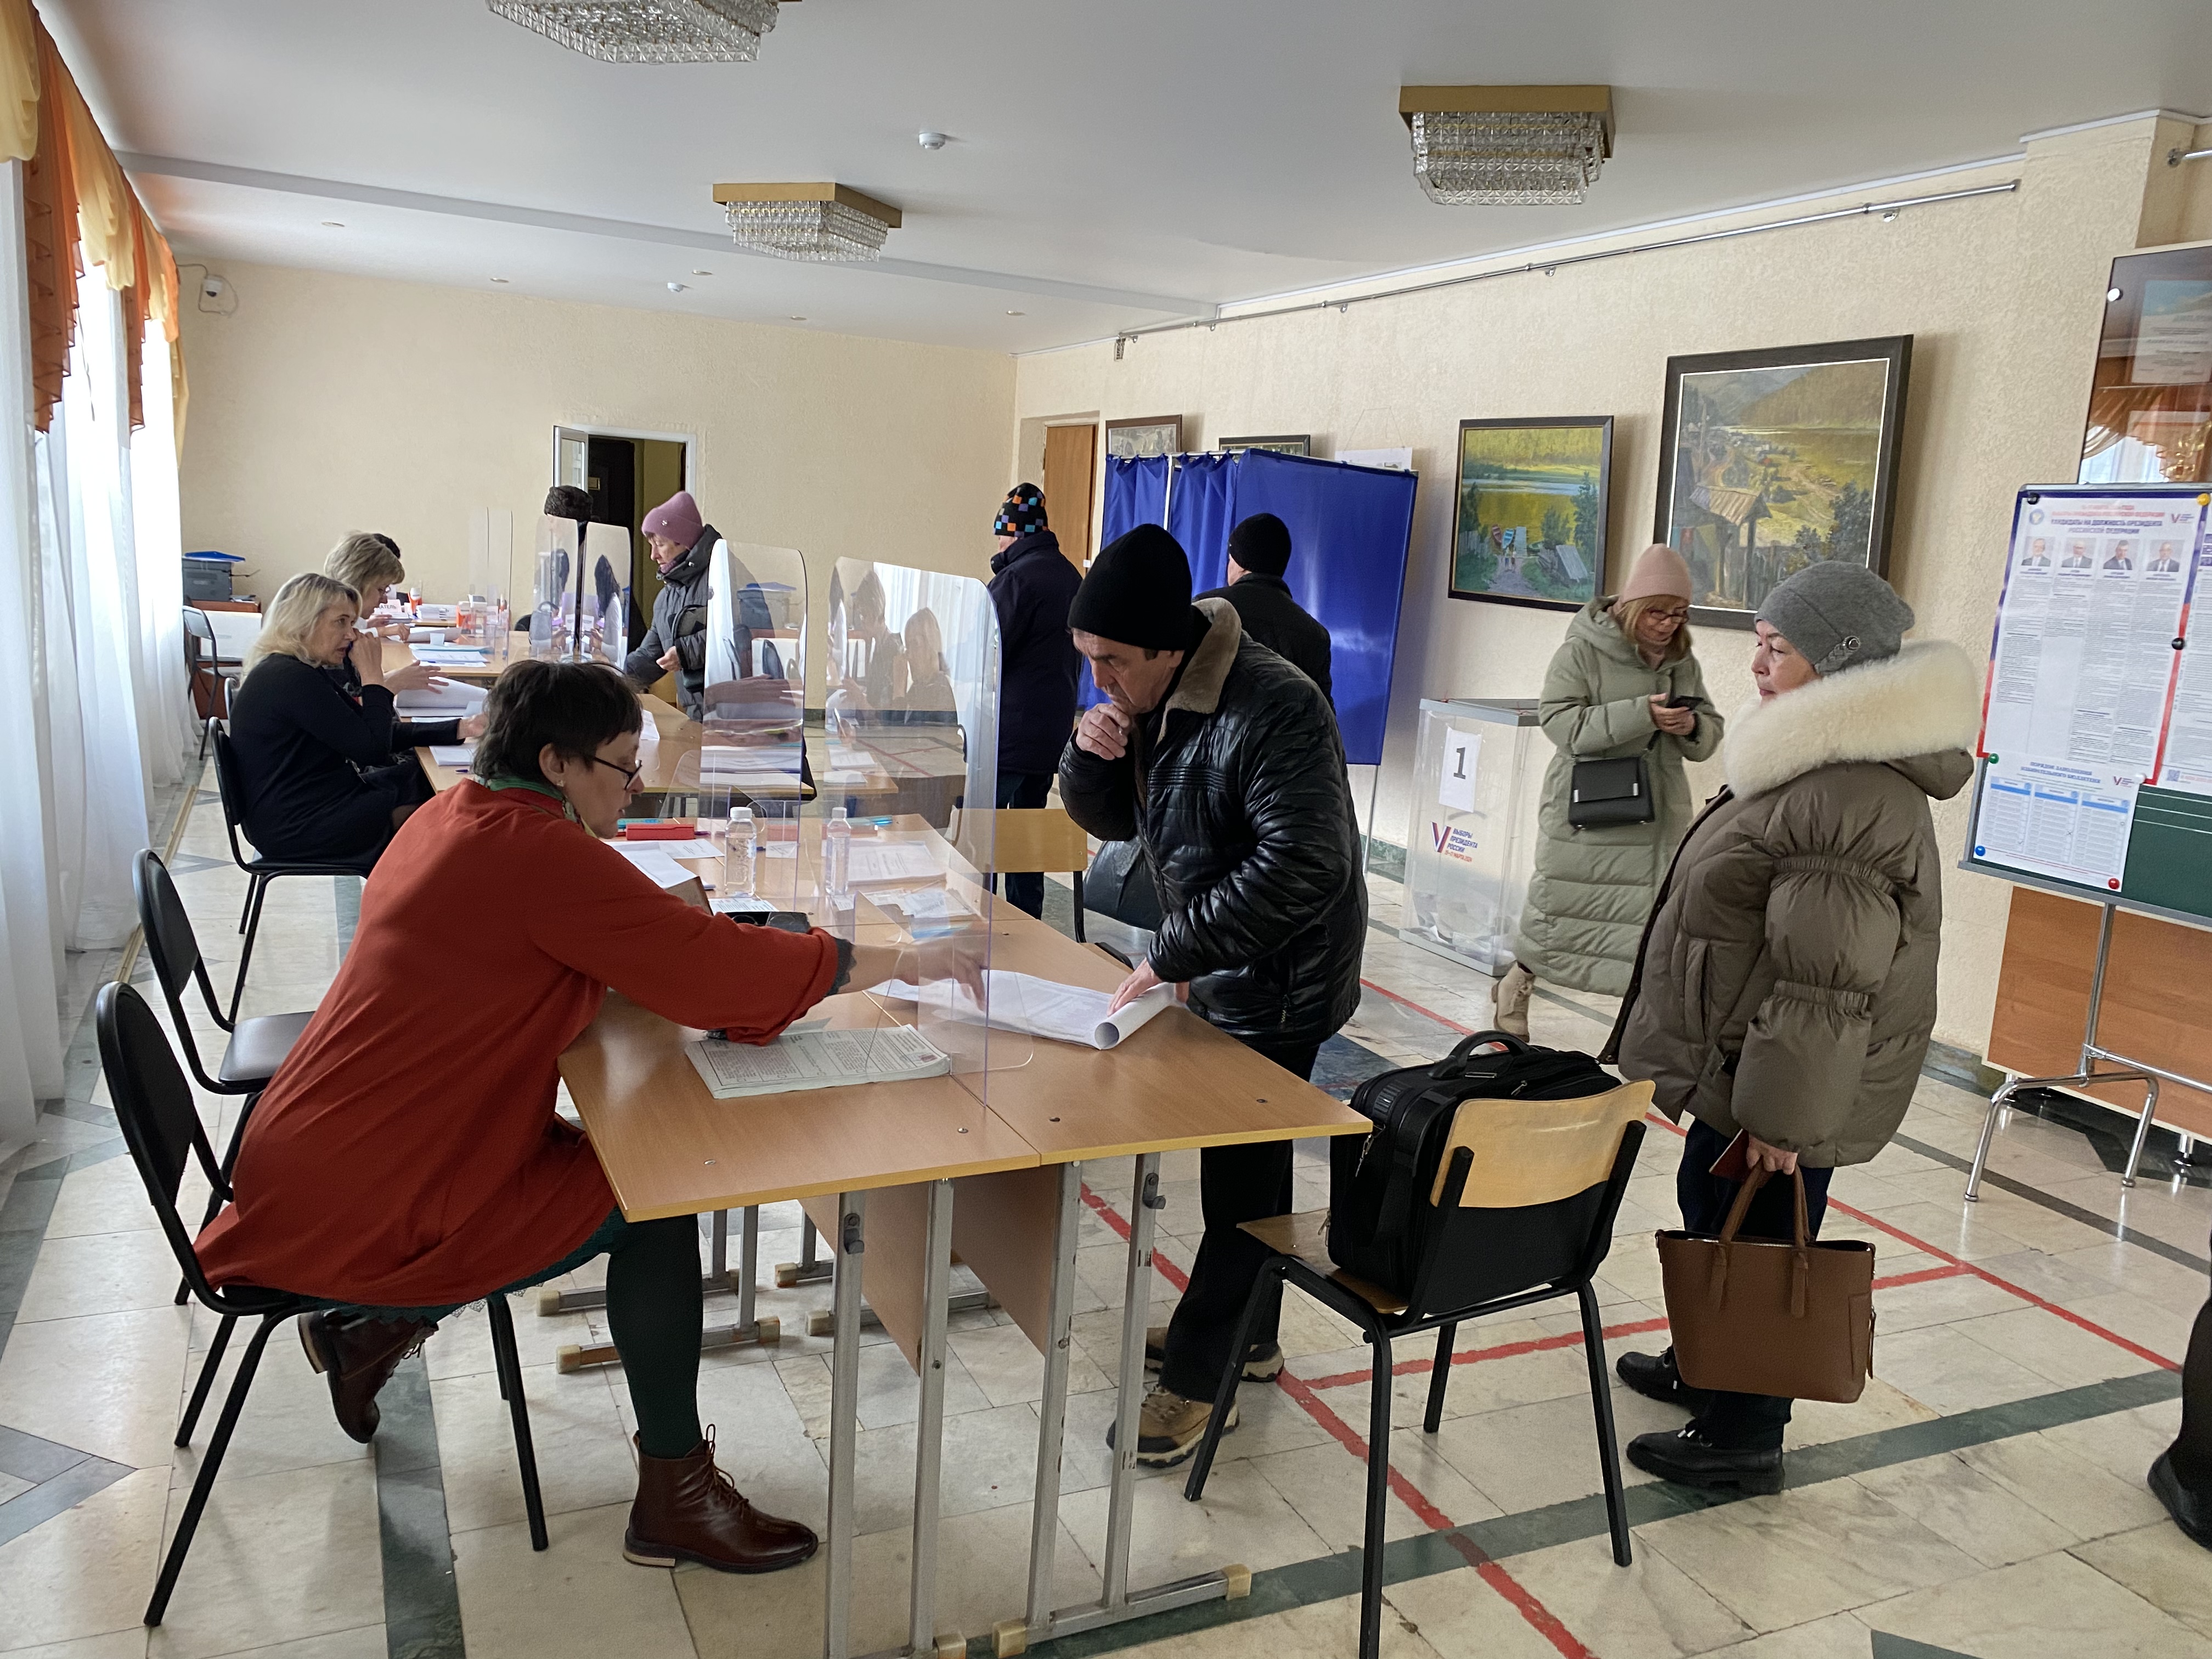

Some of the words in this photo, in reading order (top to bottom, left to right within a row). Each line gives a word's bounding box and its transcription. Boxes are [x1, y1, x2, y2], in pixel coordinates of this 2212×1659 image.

[1453, 747, 1466, 780] 1
[1453, 828, 1473, 838] ВЫБОРЫ
[1449, 836, 1478, 848] ПРЕЗИДЕНТА
[1447, 843, 1465, 853] РОССИИ
